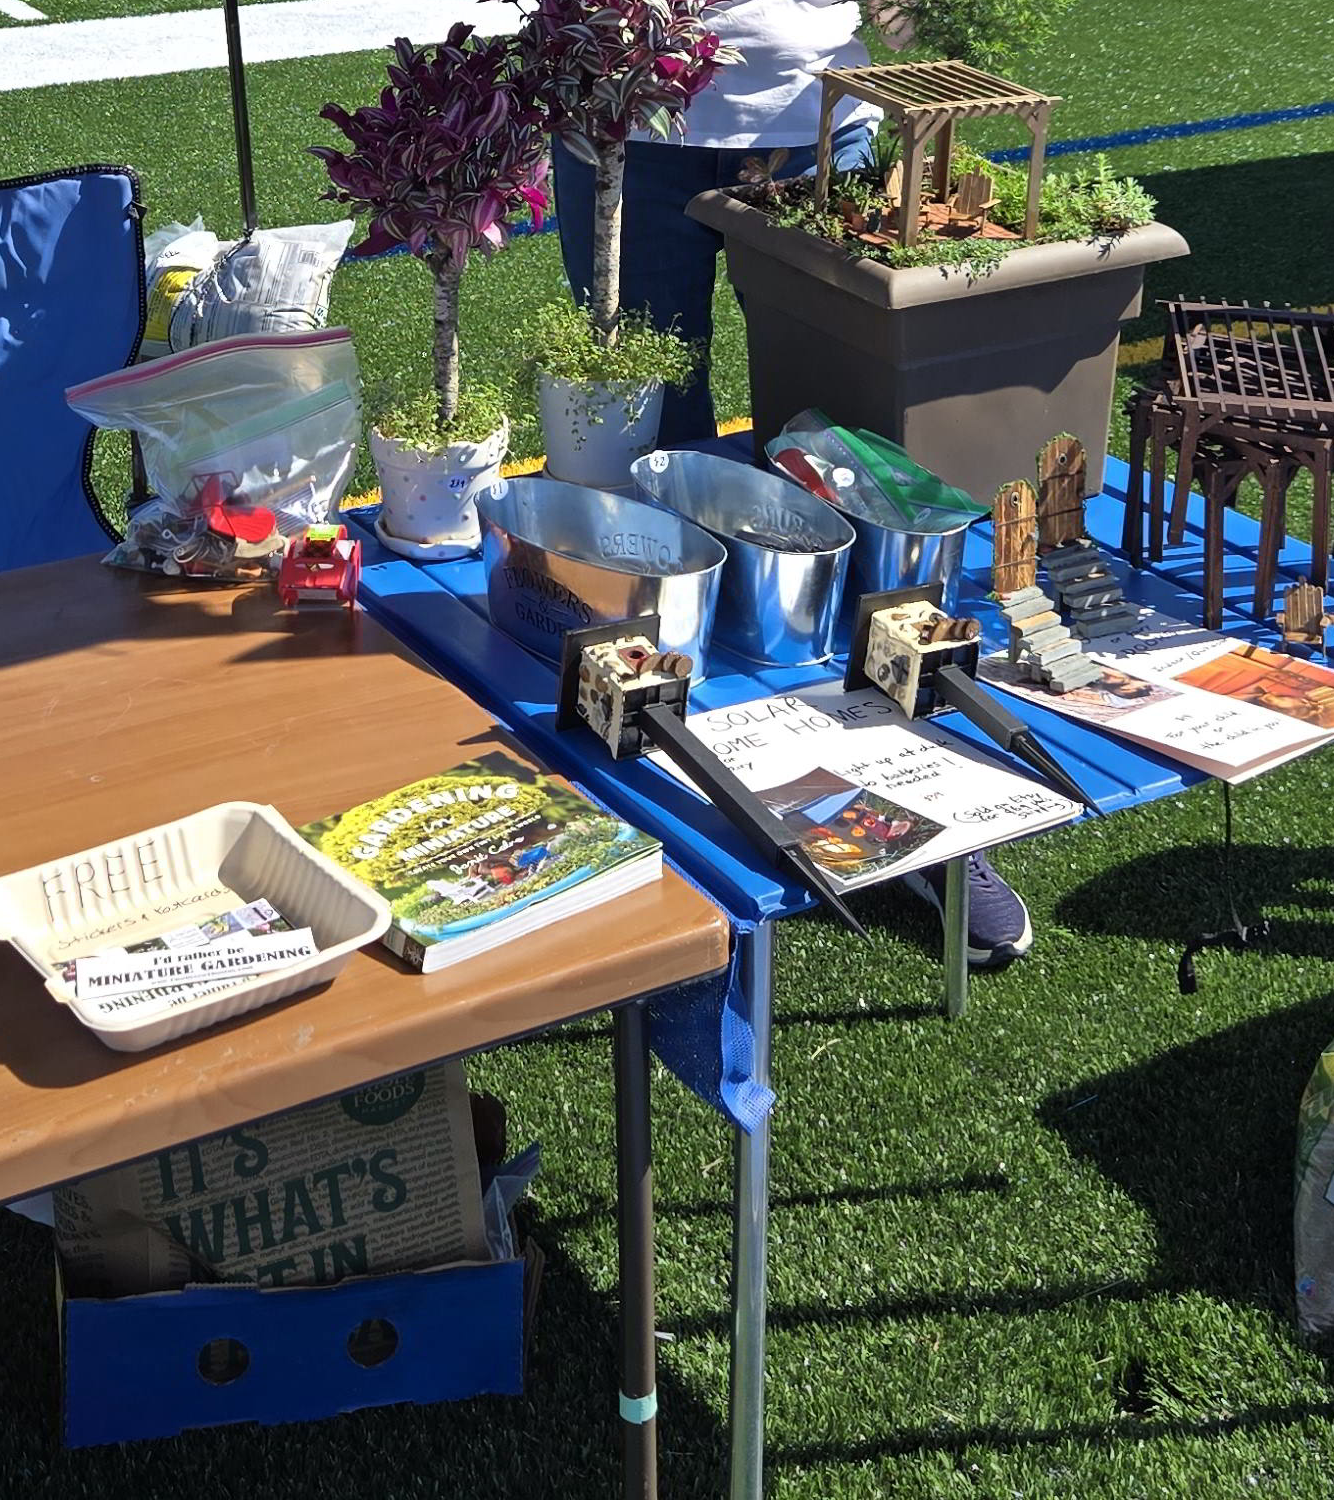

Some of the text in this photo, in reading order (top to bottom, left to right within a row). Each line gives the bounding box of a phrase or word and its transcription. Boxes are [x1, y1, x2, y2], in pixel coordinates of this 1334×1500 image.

[504, 566, 593, 624] FLOWERS
[706, 696, 818, 732] SOLAR
[712, 701, 892, 755] OME HOMES
[351, 783, 519, 859] GARDENING
[396, 805, 518, 862] MINIATURE
[42, 837, 163, 923] FREE
[88, 962, 195, 988] MINIATURE
[200, 945, 313, 972] GARDENING
[153, 945, 245, 966] I'd rather be
[353, 1080, 415, 1109] FOODS
[167, 1149, 407, 1264] WHAT'S
